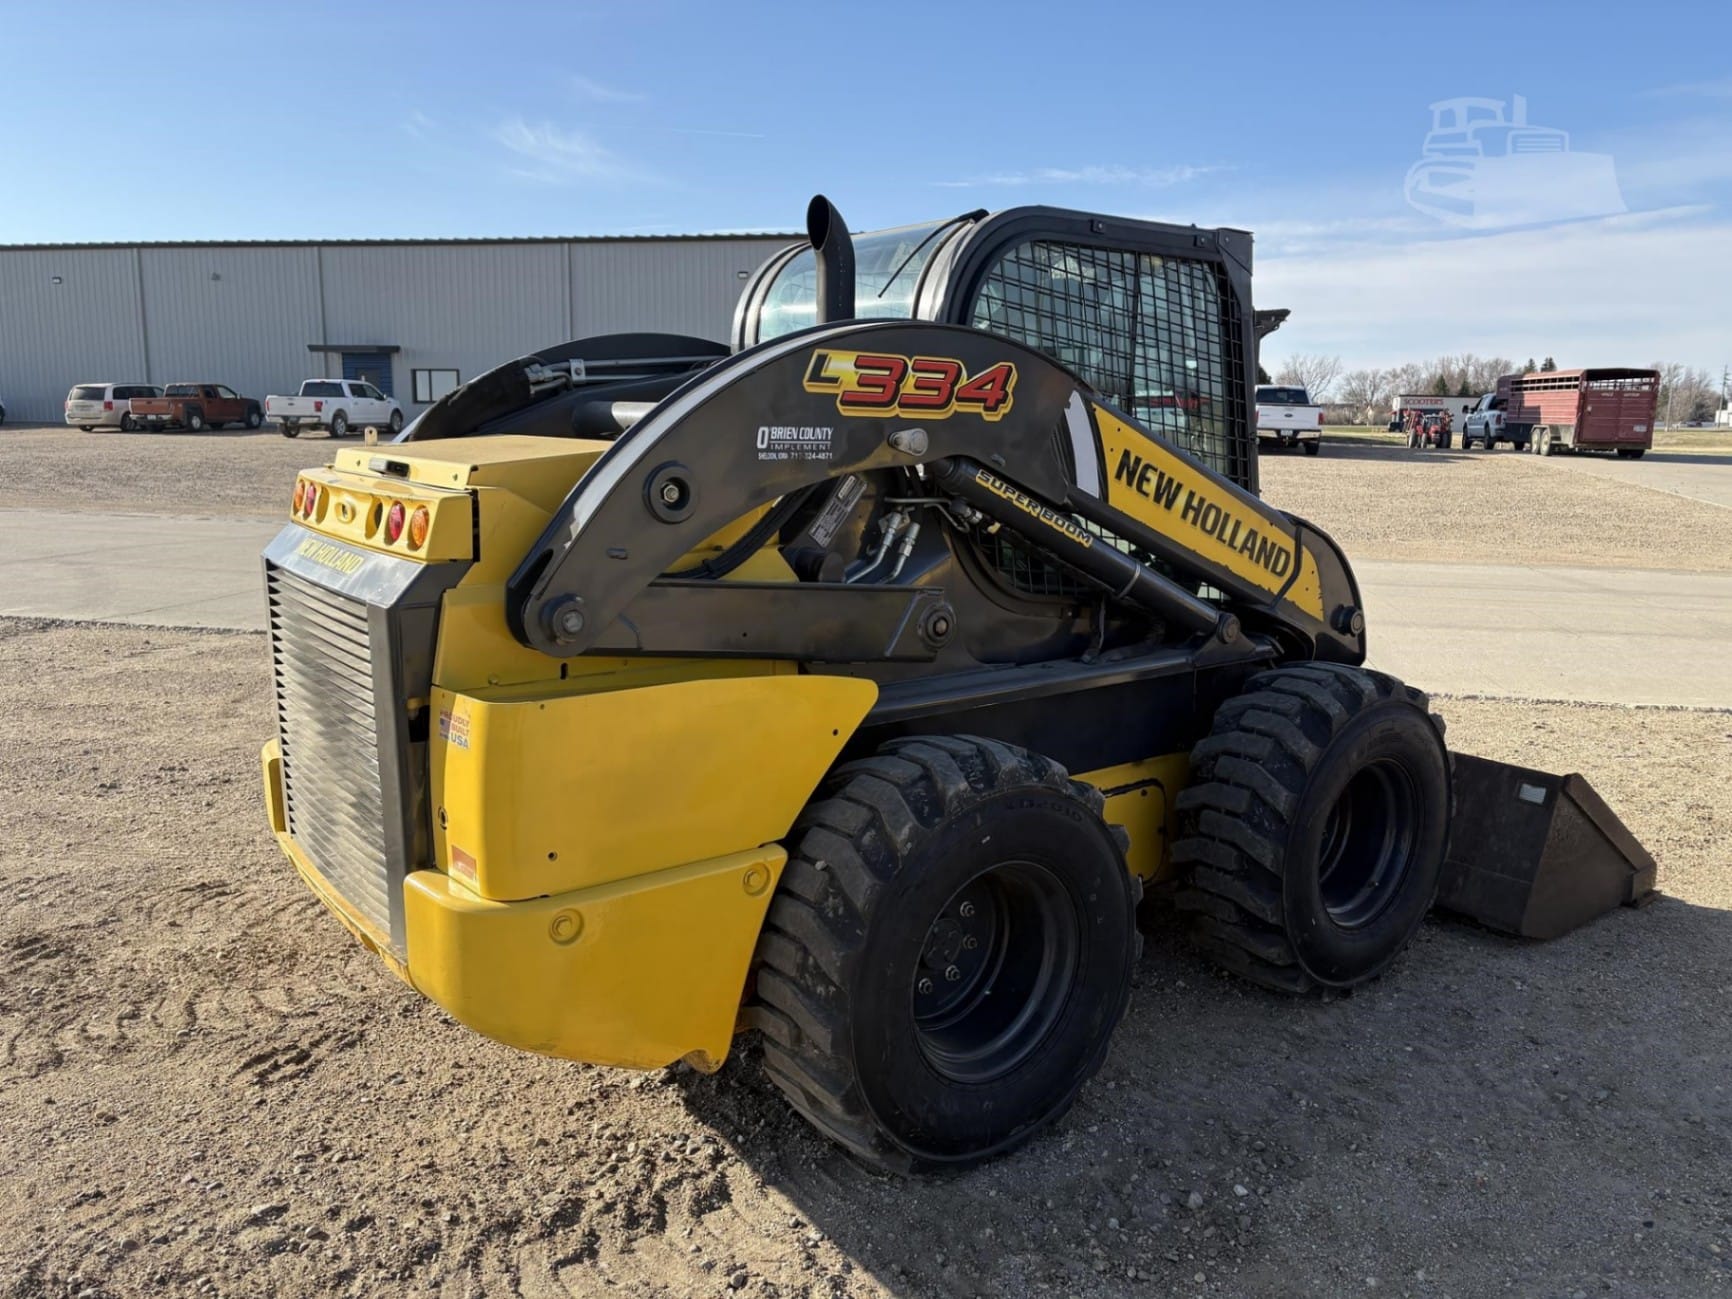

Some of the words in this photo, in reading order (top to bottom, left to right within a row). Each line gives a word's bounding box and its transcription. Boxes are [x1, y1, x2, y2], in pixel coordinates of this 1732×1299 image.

[804, 349, 1017, 421] L334
[799, 426, 834, 441] COUNTY
[770, 443, 832, 451] IMPLEMENT
[1115, 449, 1183, 510] NEW
[1181, 488, 1291, 578] HOLLAND
[450, 732, 468, 748] USA
